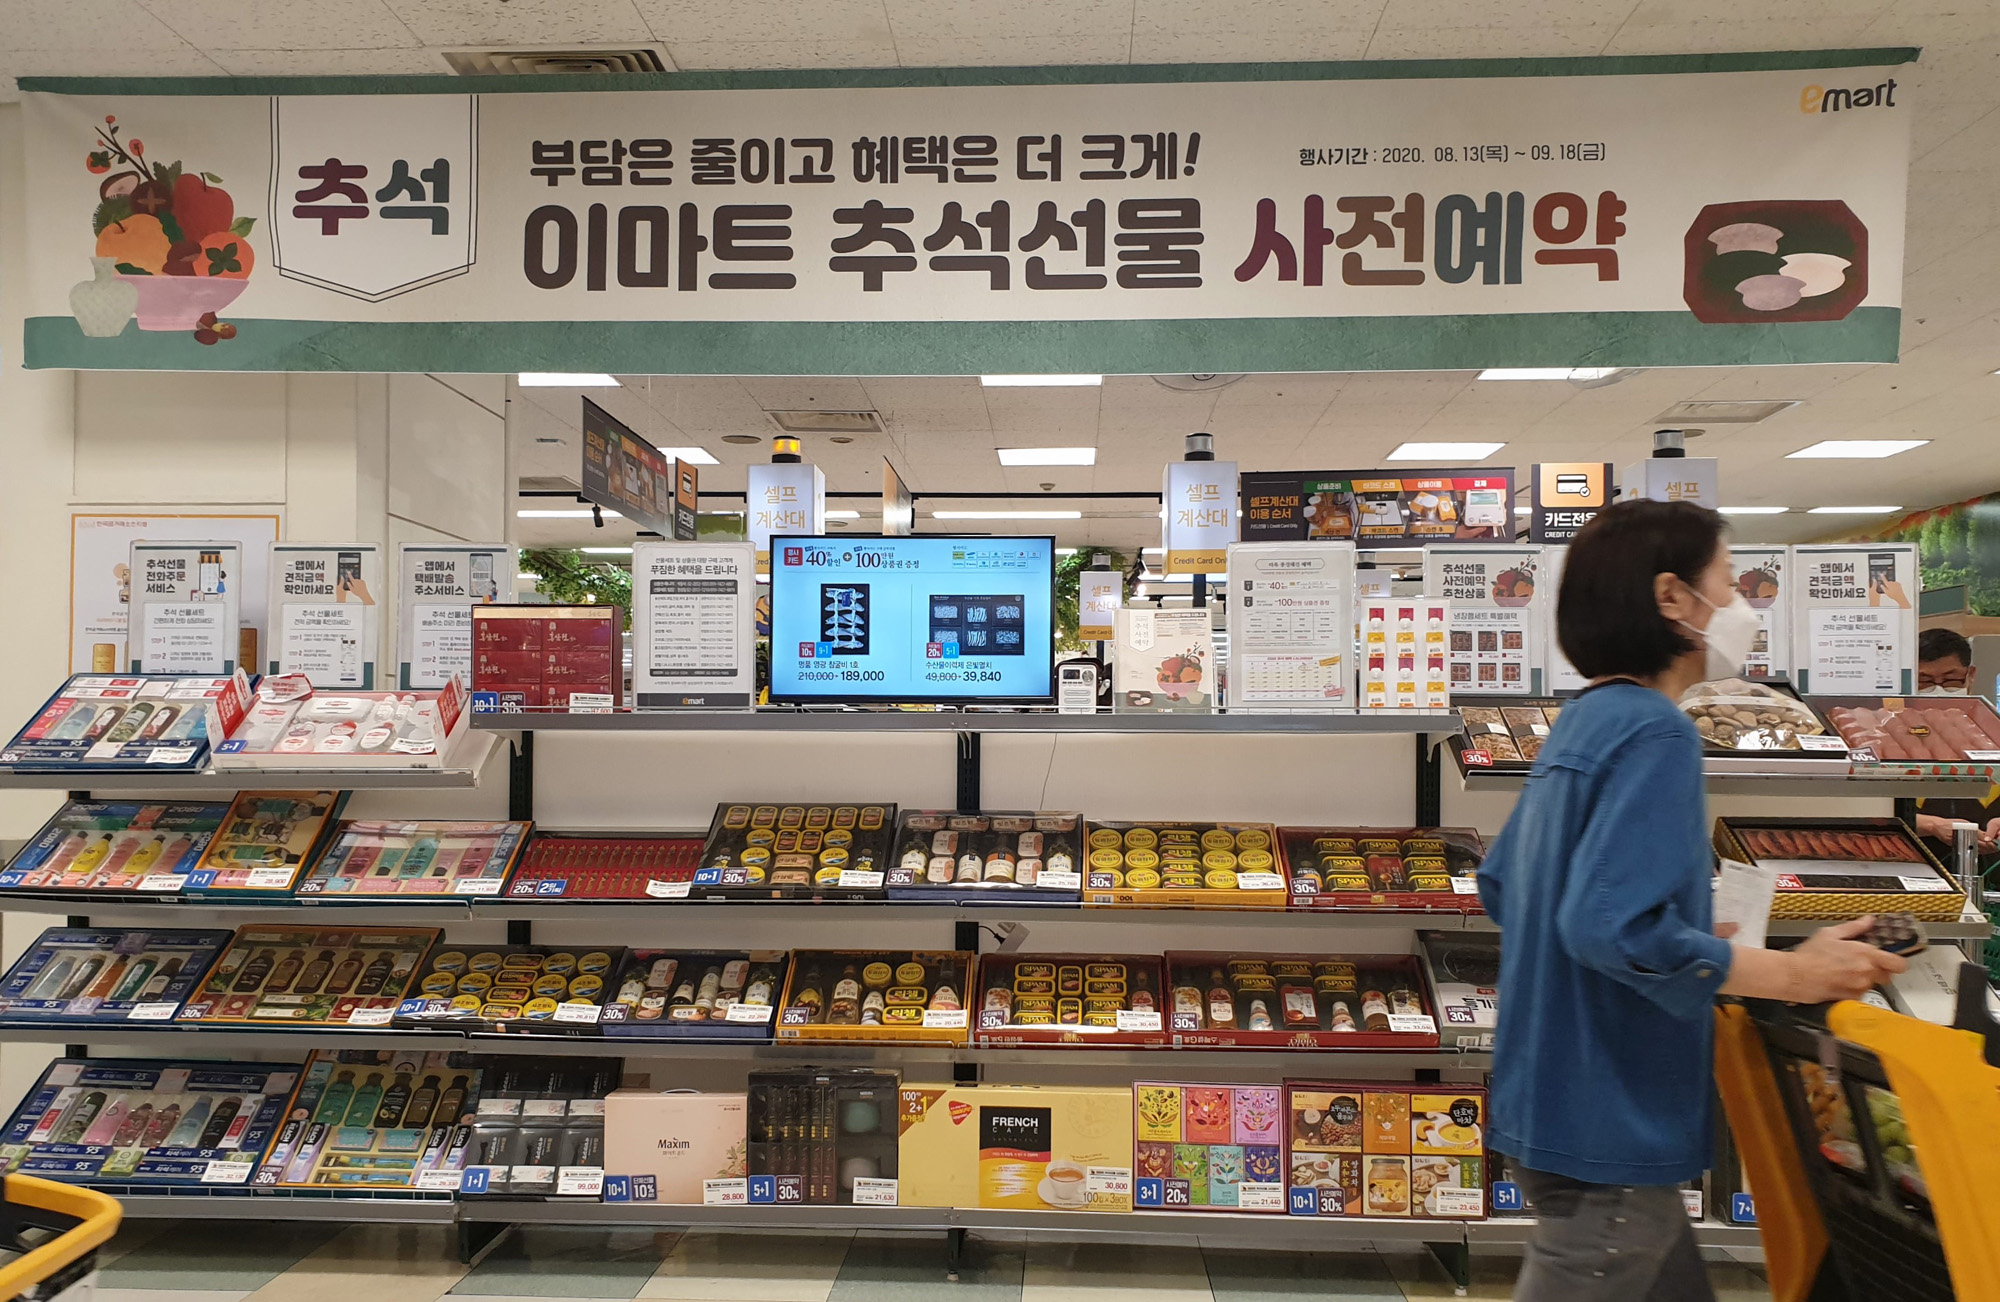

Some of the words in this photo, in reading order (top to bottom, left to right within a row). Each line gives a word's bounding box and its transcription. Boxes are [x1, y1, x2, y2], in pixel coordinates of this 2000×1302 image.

[1802, 78, 1896, 114] emart
[530, 139, 674, 187] 부담은
[690, 137, 836, 185] 줄이고
[851, 135, 999, 184] 혜택은
[1017, 133, 1062, 182] 더
[1079, 132, 1201, 181] 크게!
[1299, 148, 1369, 166] 행사기간
[1382, 147, 1425, 164] 2020.
[295, 158, 451, 236] 추석
[523, 202, 797, 292] 이마트
[828, 198, 1205, 292] 추석선물
[1234, 190, 1628, 287] 사전예약
[764, 485, 797, 503] 셀프
[1186, 483, 1220, 502] 셀프
[1664, 481, 1699, 499] 셀프
[1250, 495, 1299, 507] 셀프계산대
[756, 510, 806, 529] 계산대
[1177, 508, 1228, 528] 계산대
[1250, 509, 1269, 519] 이용
[1272, 509, 1291, 519] 순서
[146, 559, 186, 570] 추석선물
[295, 560, 325, 571] 앱에서
[881, 559, 903, 569] 상품권
[1173, 556, 1195, 565] Credit
[1197, 556, 1213, 565] Card
[425, 561, 455, 572] 앱에서
[650, 565, 676, 575] 푸짐한
[677, 565, 703, 575] 혜택을
[704, 565, 738, 575] 드립니다
[1443, 563, 1486, 574] 추석선물
[1820, 562, 1854, 573] 앱에서
[146, 571, 186, 582] 전화주문
[284, 572, 325, 583] 견적금액
[414, 573, 454, 584] 택배발송
[1443, 576, 1486, 587] 사전예약
[1809, 575, 1855, 587] 견적금액
[146, 583, 175, 594] 서비스
[284, 584, 334, 595] 확인하세요
[414, 585, 465, 596] 주소서비스
[1091, 585, 1112, 597] 셀프
[1443, 588, 1486, 599] 추천상품
[1809, 587, 1866, 599] 확인하세요
[1831, 614, 1845, 623] 추석
[798, 671, 835, 681] 210,000
[841, 670, 884, 682] 189,000
[963, 670, 1001, 682] 39,840
[683, 697, 705, 705] emart
[221, 743, 240, 751] 5+1
[1466, 754, 1489, 764] 30%
[1852, 752, 1876, 762] 40%
[1414, 859, 1442, 867] SPAM
[192, 873, 209, 884] 1+1
[697, 871, 718, 881] 10+1
[724, 873, 744, 883] 30%
[890, 873, 910, 883] 30%
[302, 883, 322, 893] 20%
[1090, 878, 1110, 888] 30%
[1294, 883, 1316, 893] 30%
[513, 885, 534, 894] 20%
[1242, 978, 1270, 987] SPAM
[1325, 979, 1353, 988] SPAM
[894, 989, 918, 998] 리챔
[401, 1001, 422, 1011] 10+1
[426, 1003, 447, 1012] 30%
[181, 1009, 201, 1017] 30%
[604, 1010, 625, 1019] 30%
[784, 1014, 804, 1023] 30%
[891, 1009, 916, 1017] 리챔
[1450, 1013, 1471, 1022] 30%
[982, 1016, 1002, 1026] 30%
[1174, 1019, 1196, 1029] 30%
[902, 1091, 916, 1101] 100
[909, 1095, 928, 1114] 2+1
[992, 1116, 1038, 1127] FRENCH
[657, 1137, 690, 1150] Maxim
[255, 1173, 277, 1183] 30%
[468, 1173, 484, 1187] 1+1
[607, 1180, 626, 1196] 10+1
[1105, 1181, 1128, 1190] 30,800
[1166, 1180, 1189, 1188] 사전예약
[634, 1185, 655, 1198] 10%
[753, 1182, 769, 1198] 5+1
[778, 1185, 799, 1199] 30%
[1141, 1184, 1157, 1199] 3+1
[1166, 1188, 1188, 1203] 20%
[722, 1193, 744, 1201] 28,800
[1292, 1193, 1314, 1208] 10+1
[1499, 1188, 1515, 1204] 5+1
[1261, 1198, 1281, 1206] 21,440
[1320, 1197, 1342, 1212] 30%
[1459, 1203, 1480, 1211] 23,450
